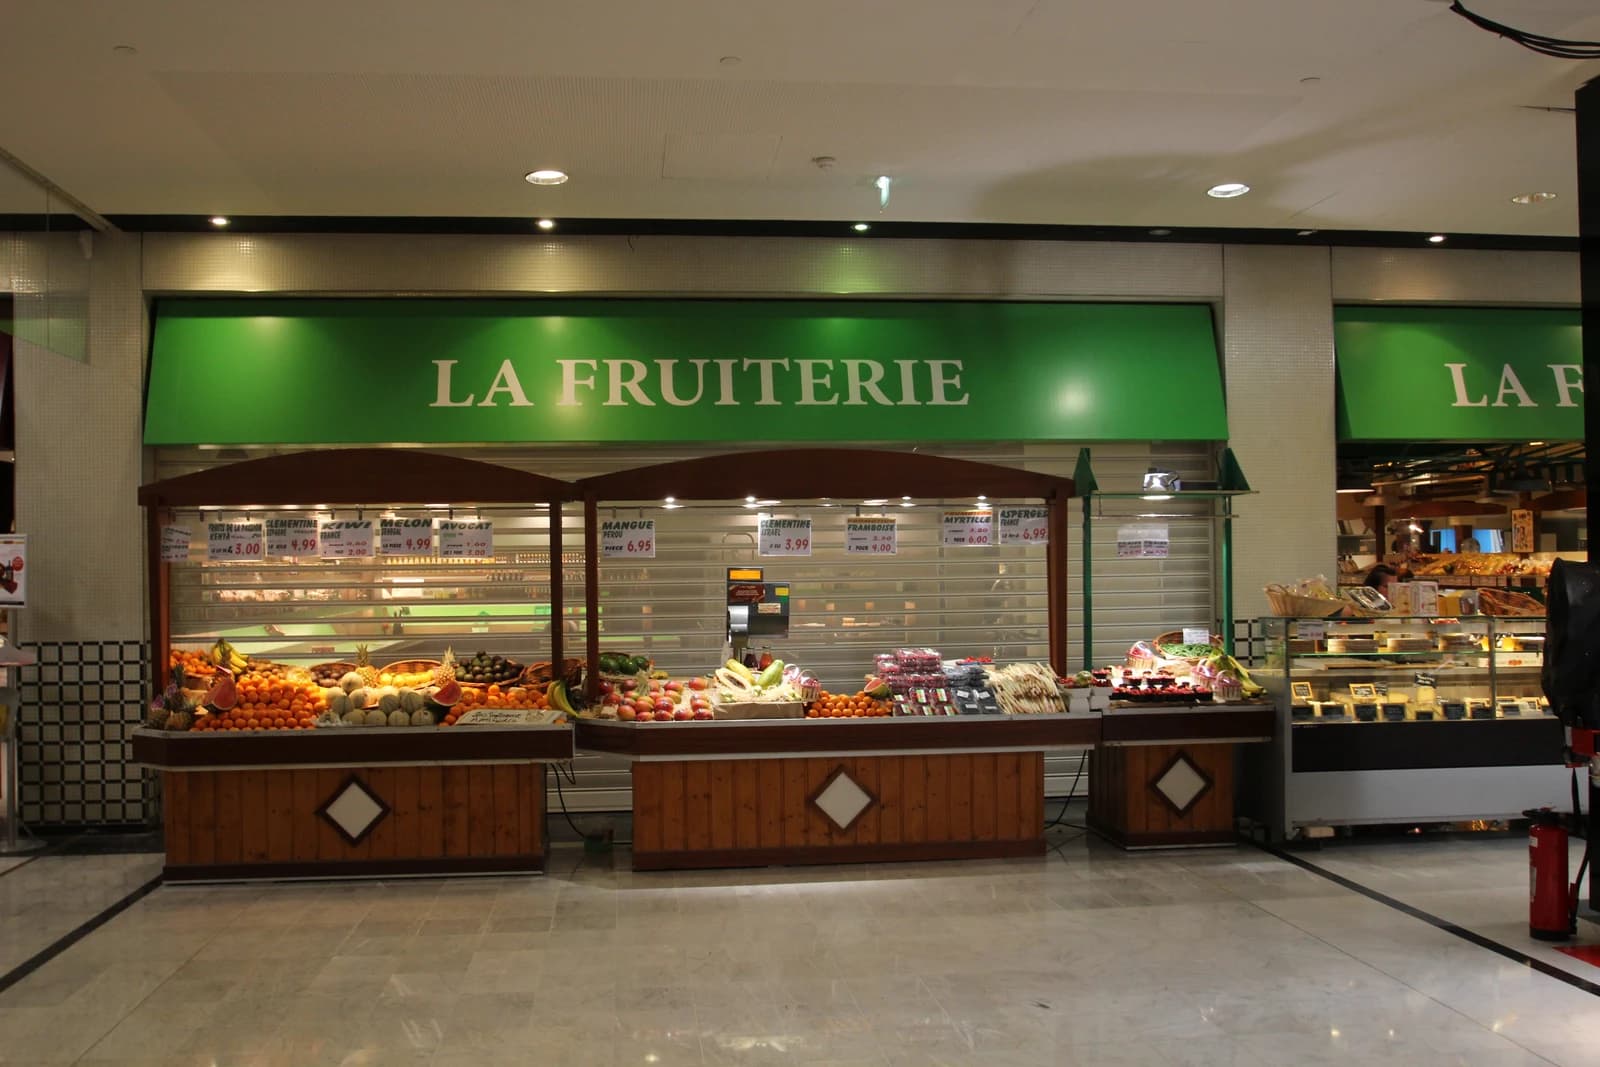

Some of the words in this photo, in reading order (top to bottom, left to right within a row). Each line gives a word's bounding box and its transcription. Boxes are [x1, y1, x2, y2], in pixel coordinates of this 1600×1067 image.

[429, 358, 535, 407] LA
[556, 357, 970, 407] FRUITERIE
[1443, 363, 1539, 407] LA
[380, 518, 432, 528] MELON
[602, 520, 654, 530] MANGUE
[760, 519, 811, 529] CLEMENTINE
[944, 516, 992, 524] MYRTILLE
[322, 521, 372, 530] KIWI
[440, 521, 492, 530] AVOCAT
[847, 524, 895, 532] FRAMBOISE
